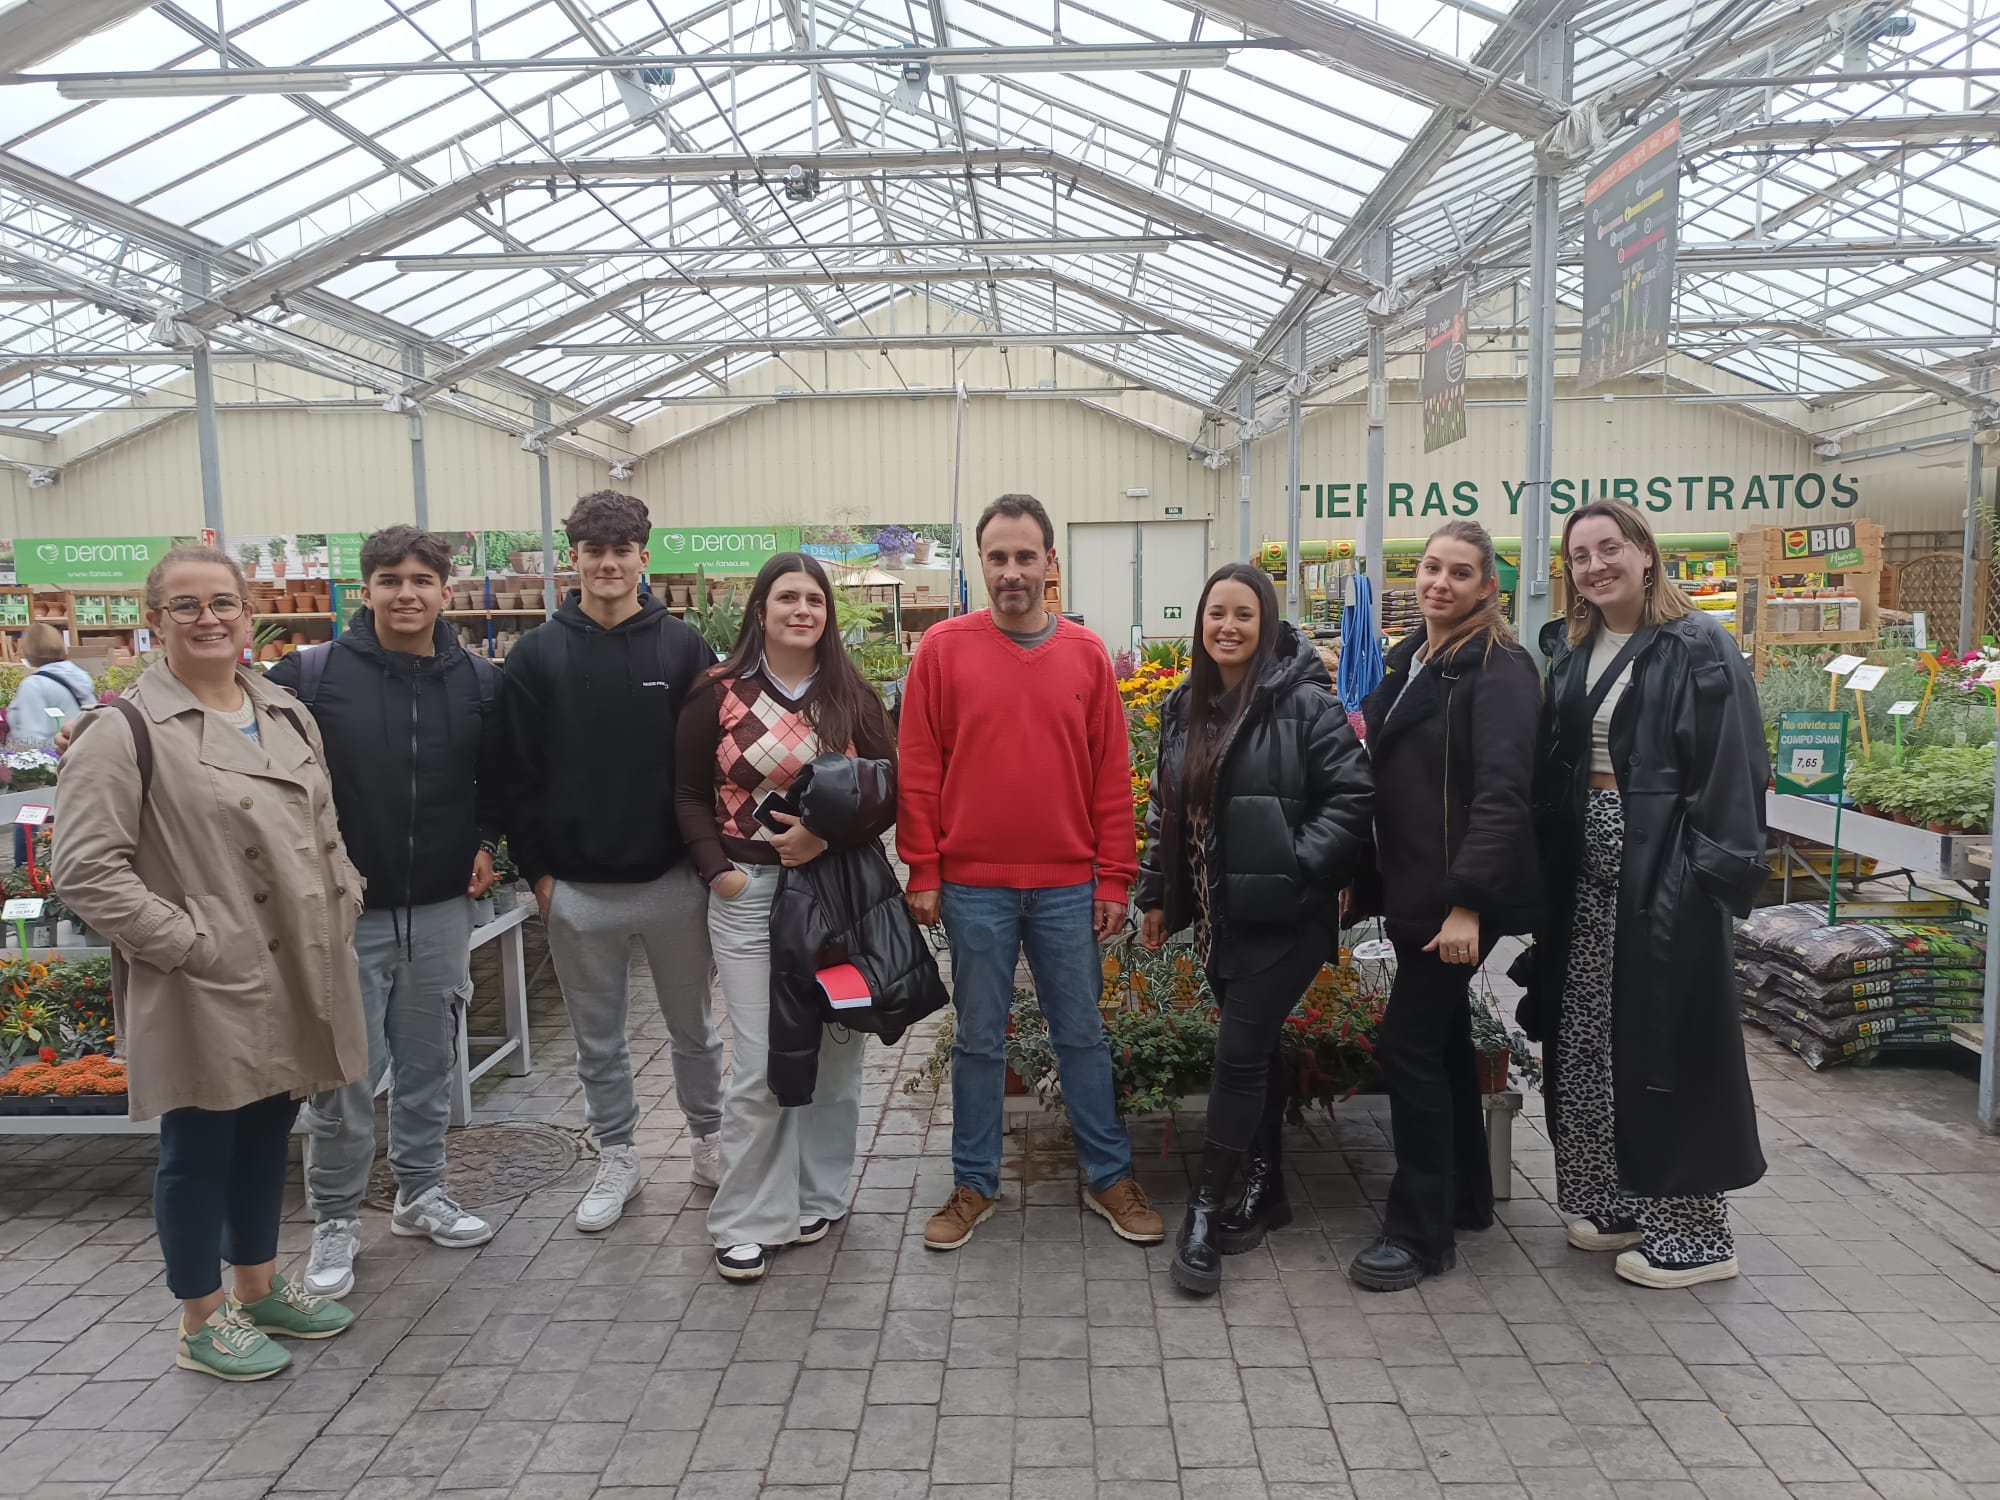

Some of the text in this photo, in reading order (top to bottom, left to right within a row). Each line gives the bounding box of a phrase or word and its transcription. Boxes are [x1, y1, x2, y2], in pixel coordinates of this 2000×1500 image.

[1501, 480, 1526, 515] Y
[1550, 472, 1859, 515] SUBSTRATOS
[690, 533, 777, 552] Deroma
[1810, 526, 1850, 552] BIO
[64, 543, 150, 563] Deroma
[1782, 720, 1841, 730] No olvide su
[1781, 735, 1840, 744] COMPO SANA
[1797, 758, 1818, 768] 7,65
[1866, 956, 1892, 972] BIO
